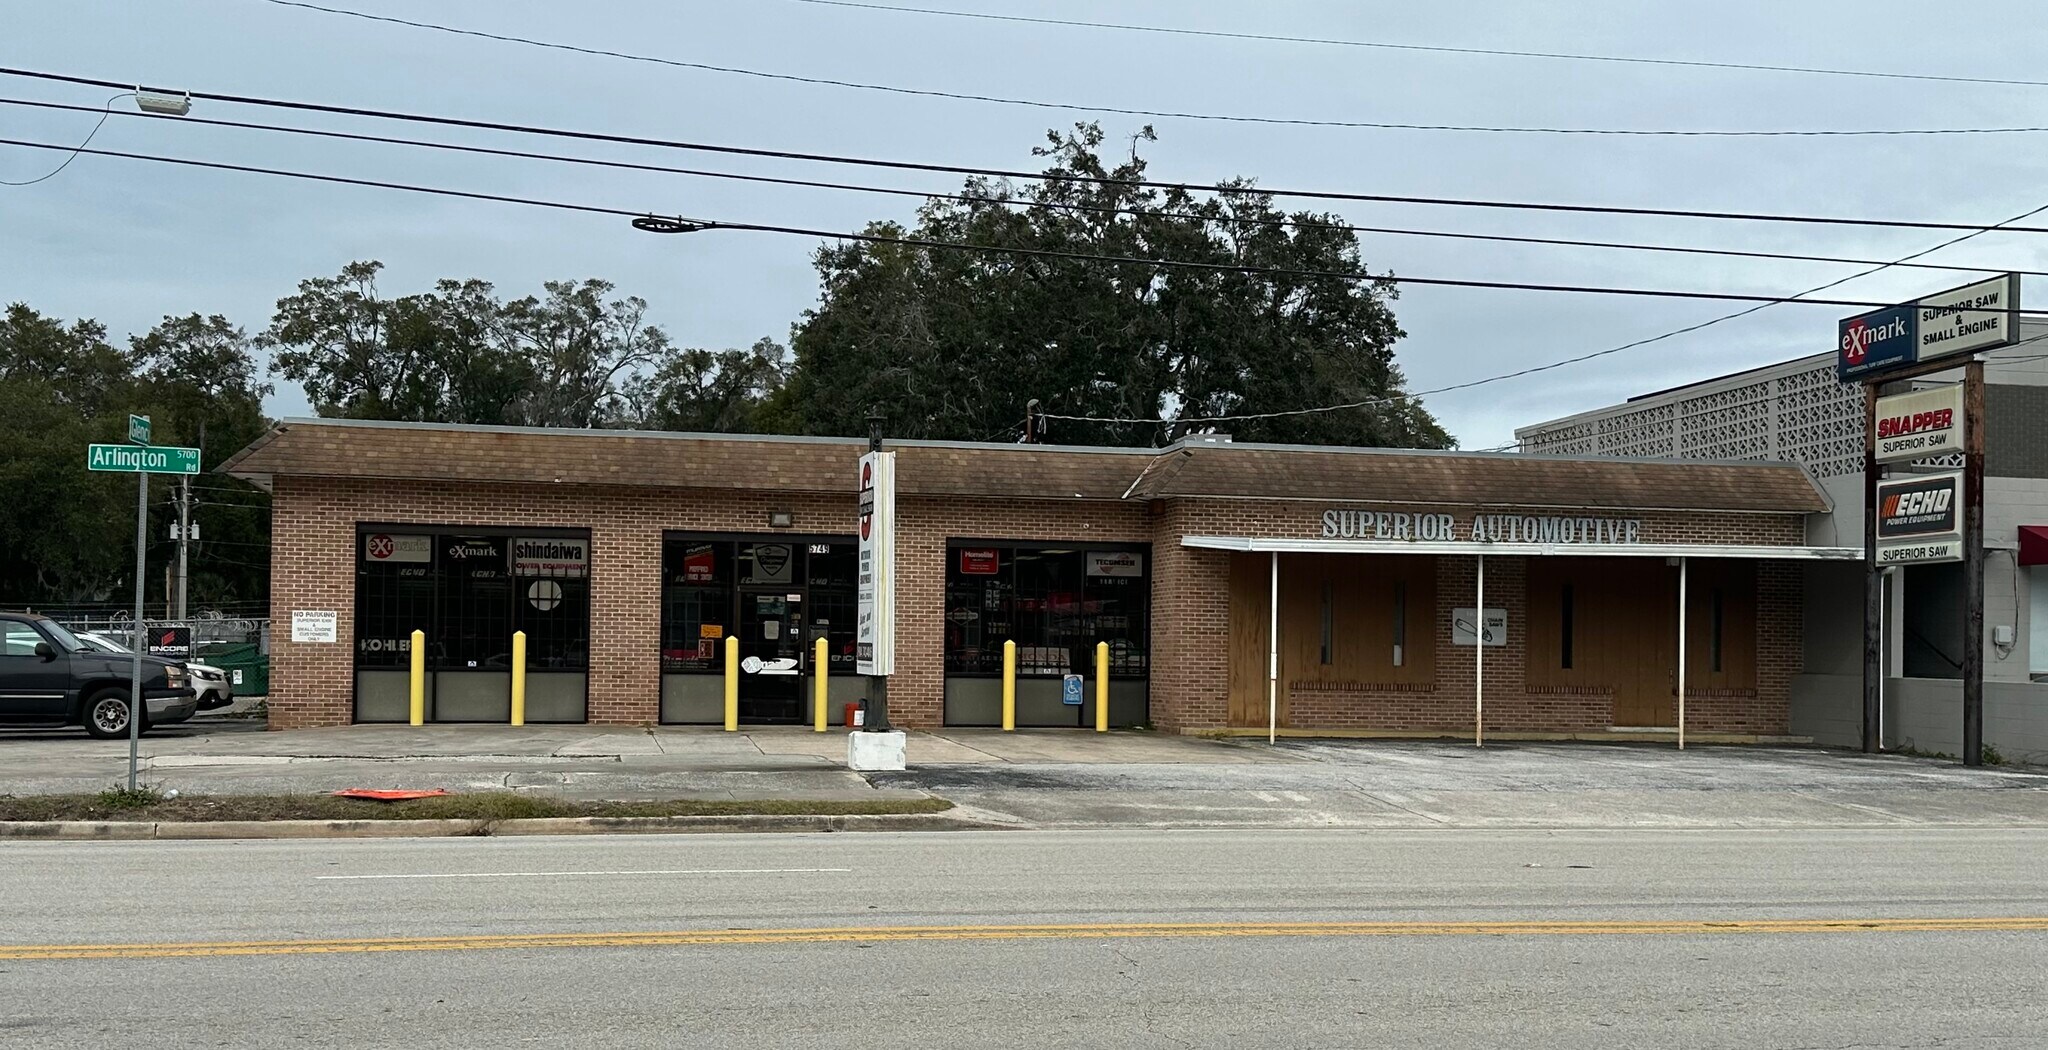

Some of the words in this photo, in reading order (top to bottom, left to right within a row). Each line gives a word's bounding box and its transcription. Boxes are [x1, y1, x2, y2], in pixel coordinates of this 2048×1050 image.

[1923, 300, 1973, 322] SUPERIOR
[1976, 293, 1998, 308] SAW
[1955, 315, 1963, 325] &
[1923, 328, 1955, 345] SMALL
[1959, 318, 1998, 337] ENGINE
[1878, 408, 1953, 437] SNAPPER
[1883, 437, 1925, 453] SUPERIOR
[1929, 434, 1947, 447] SAW
[92, 446, 167, 471] Arlington
[178, 450, 196, 460] 5700
[186, 463, 196, 472] Rd
[1895, 488, 1952, 518] ECHO
[1322, 510, 1456, 541] SUPERIOR
[1471, 514, 1641, 544] AUTOMOTIVE
[1886, 516, 1908, 526] POWER
[1908, 513, 1947, 524] EQUIPMENT
[516, 541, 582, 560] shindaiwa
[809, 544, 830, 554] 5749
[1883, 547, 1926, 561] SUPERIOR
[1929, 545, 1948, 557] SAW
[542, 563, 587, 571] EQUIPMENT
